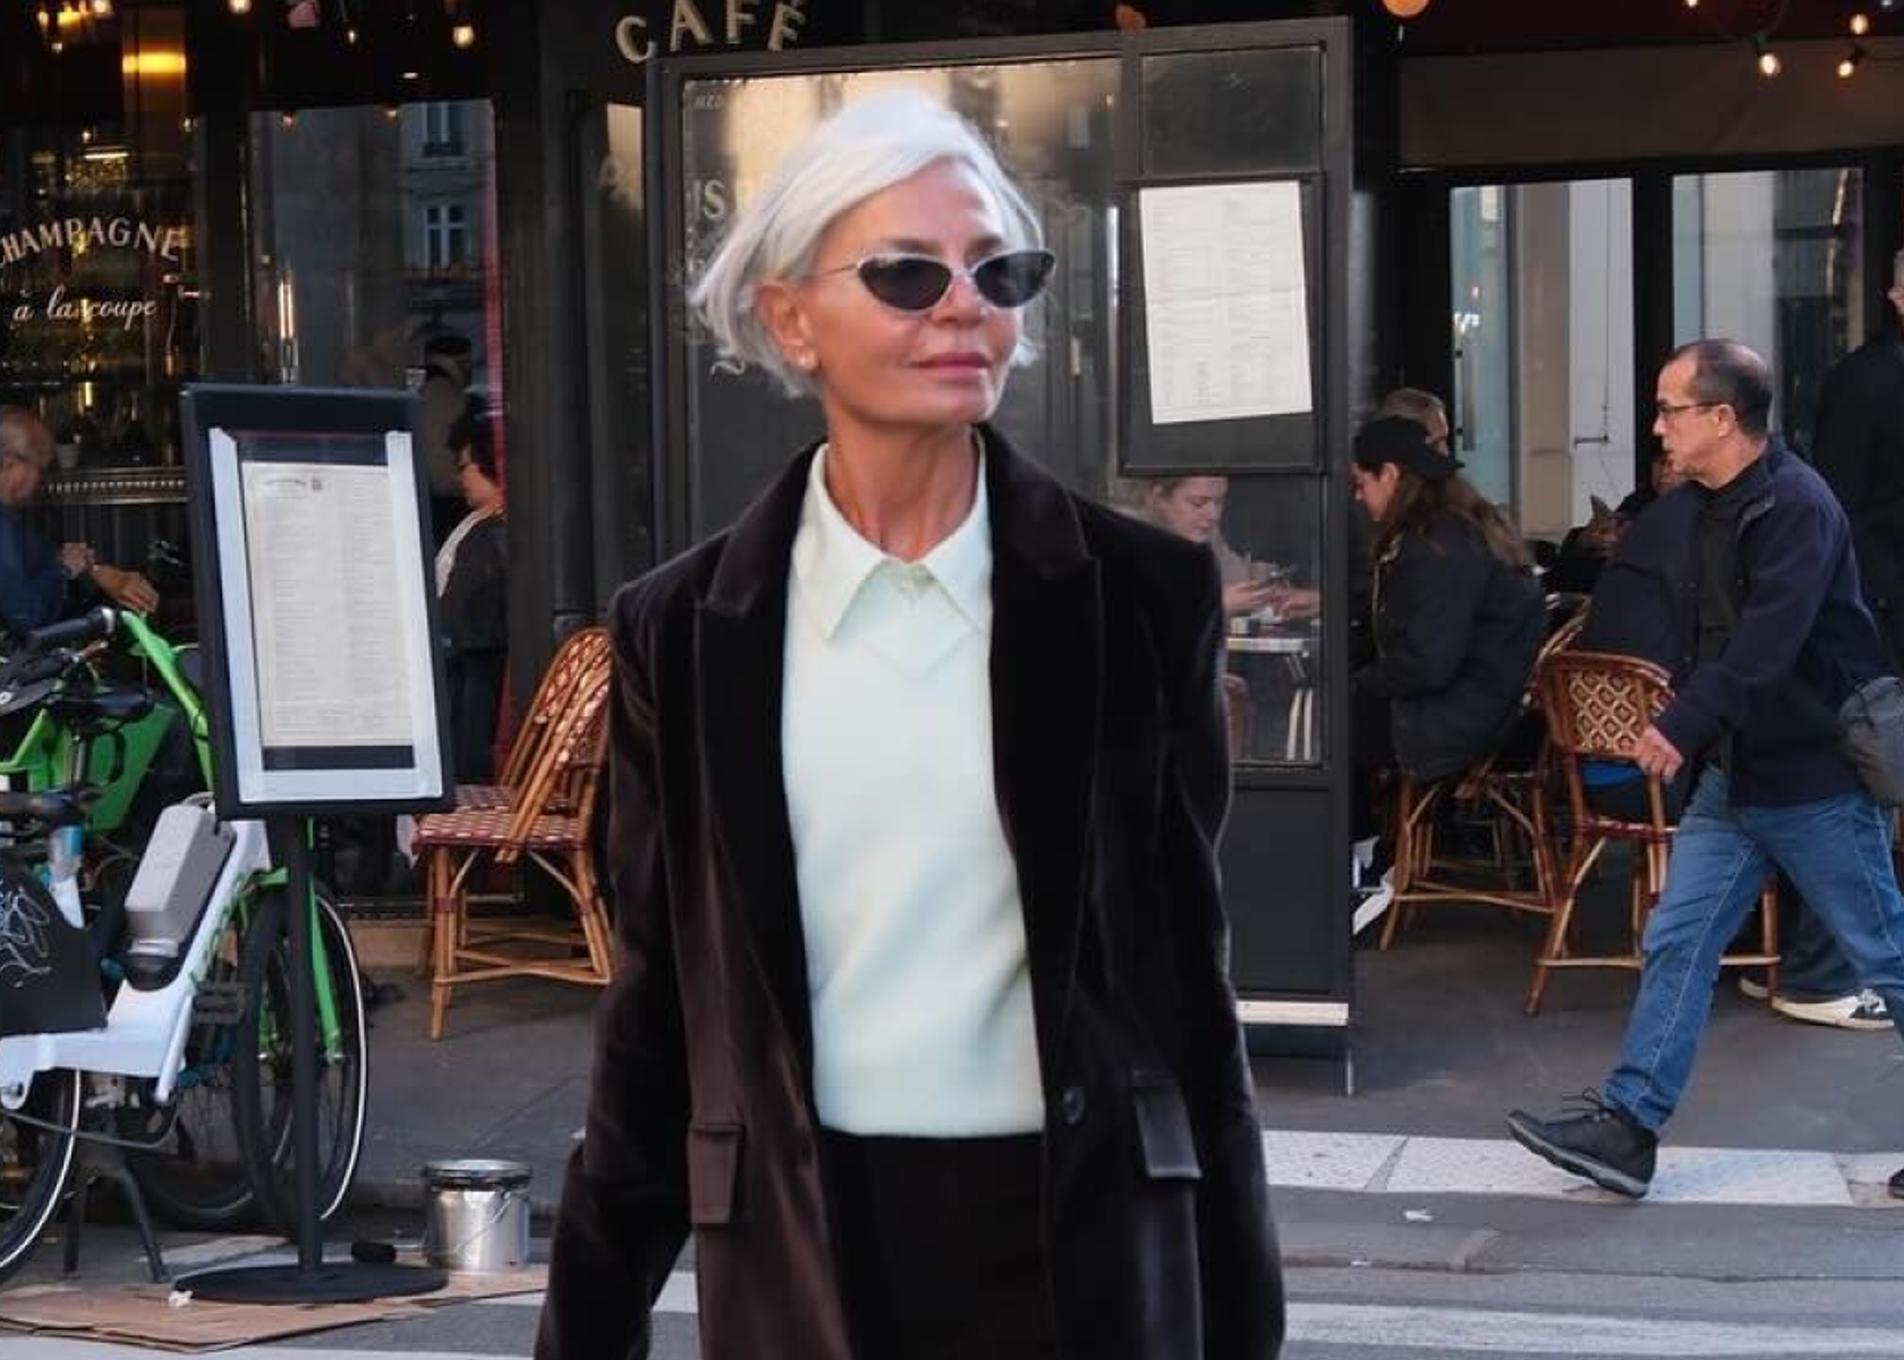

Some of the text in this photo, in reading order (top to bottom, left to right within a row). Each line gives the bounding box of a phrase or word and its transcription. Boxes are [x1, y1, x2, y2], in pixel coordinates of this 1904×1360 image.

[615, 0, 806, 64] CAFÉ
[46, 284, 79, 320] la
[90, 299, 158, 331] coupe
